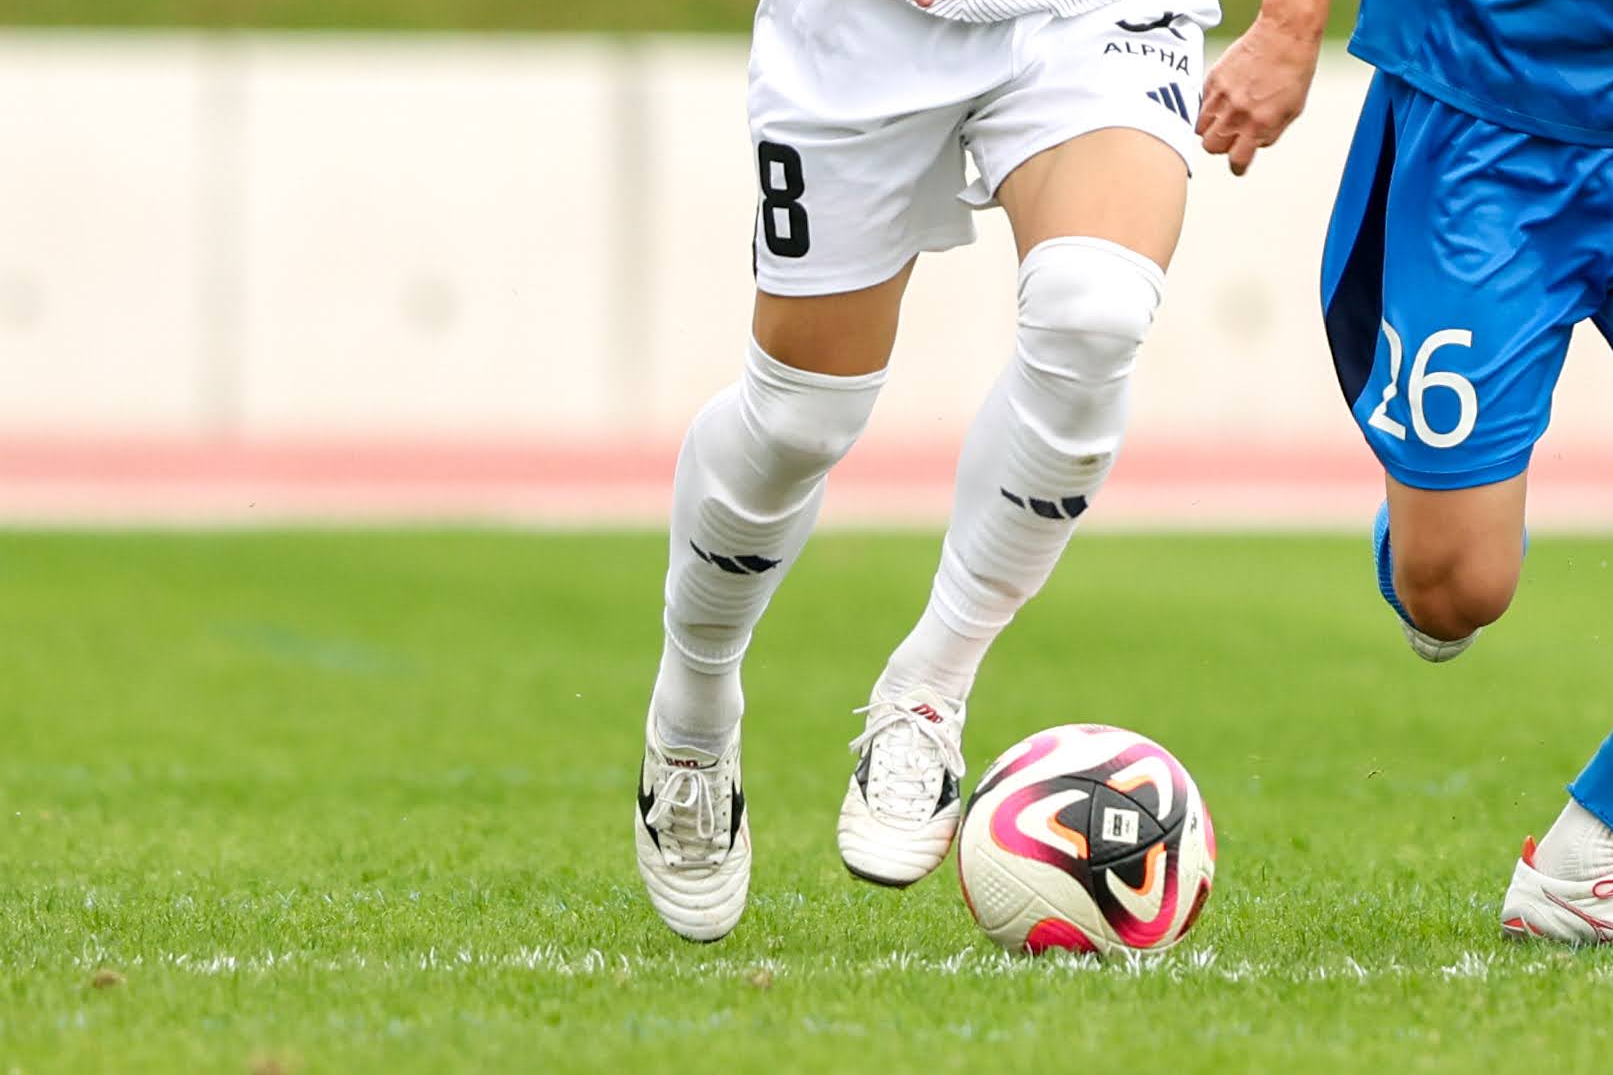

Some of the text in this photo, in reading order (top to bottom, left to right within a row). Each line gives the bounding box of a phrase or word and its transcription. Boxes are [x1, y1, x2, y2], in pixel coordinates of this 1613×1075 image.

[1103, 40, 1190, 77] ALPHA
[757, 139, 811, 259] 8
[1367, 315, 1479, 449] 26
